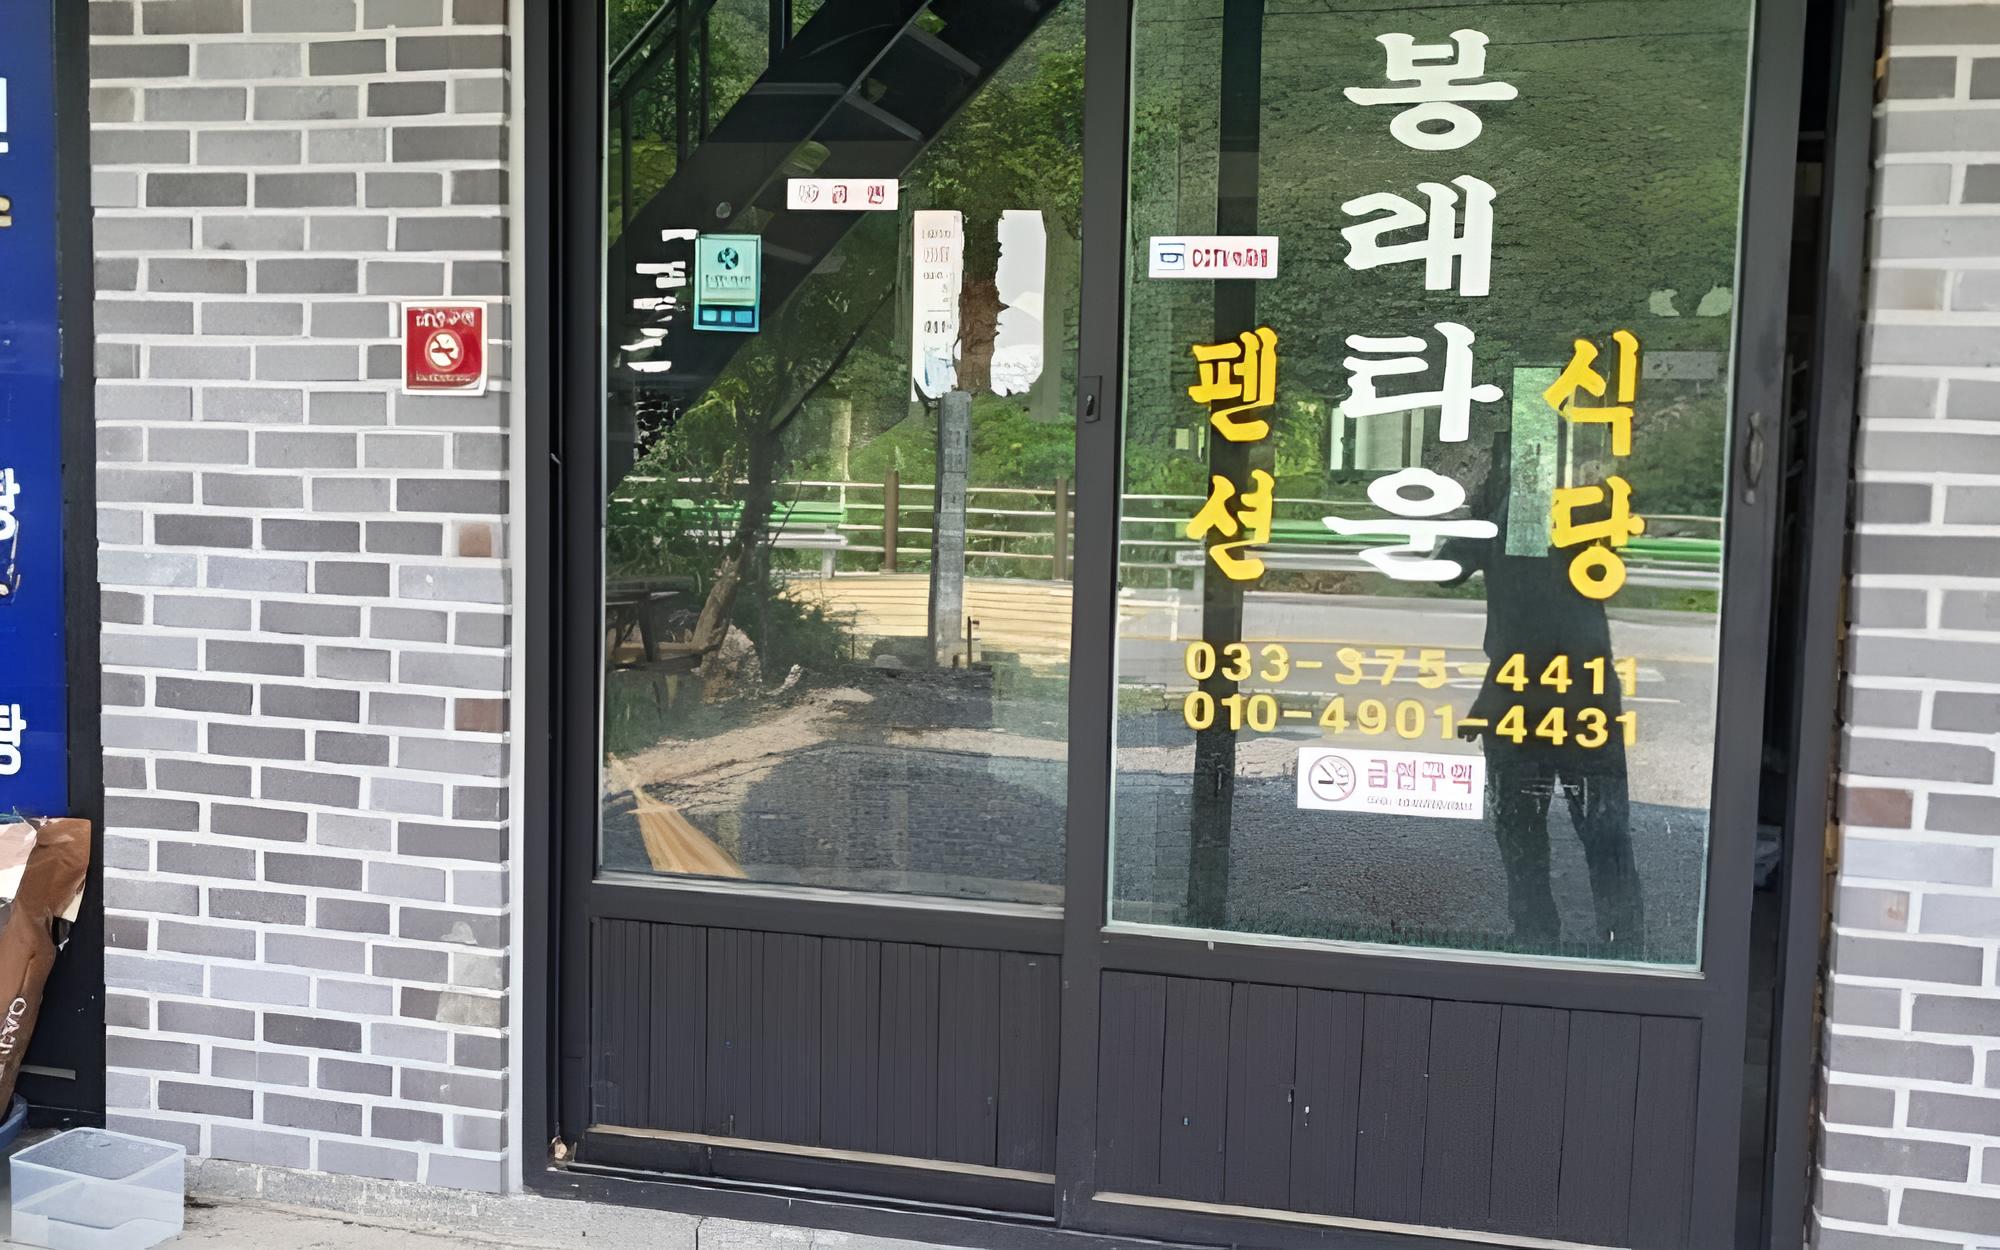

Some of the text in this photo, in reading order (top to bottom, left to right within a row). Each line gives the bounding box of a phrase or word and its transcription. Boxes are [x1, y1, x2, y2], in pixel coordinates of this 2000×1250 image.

[1321, 28, 1519, 582] 봉래타운
[1187, 326, 1279, 580] 펜션
[1542, 329, 1647, 600] 식당
